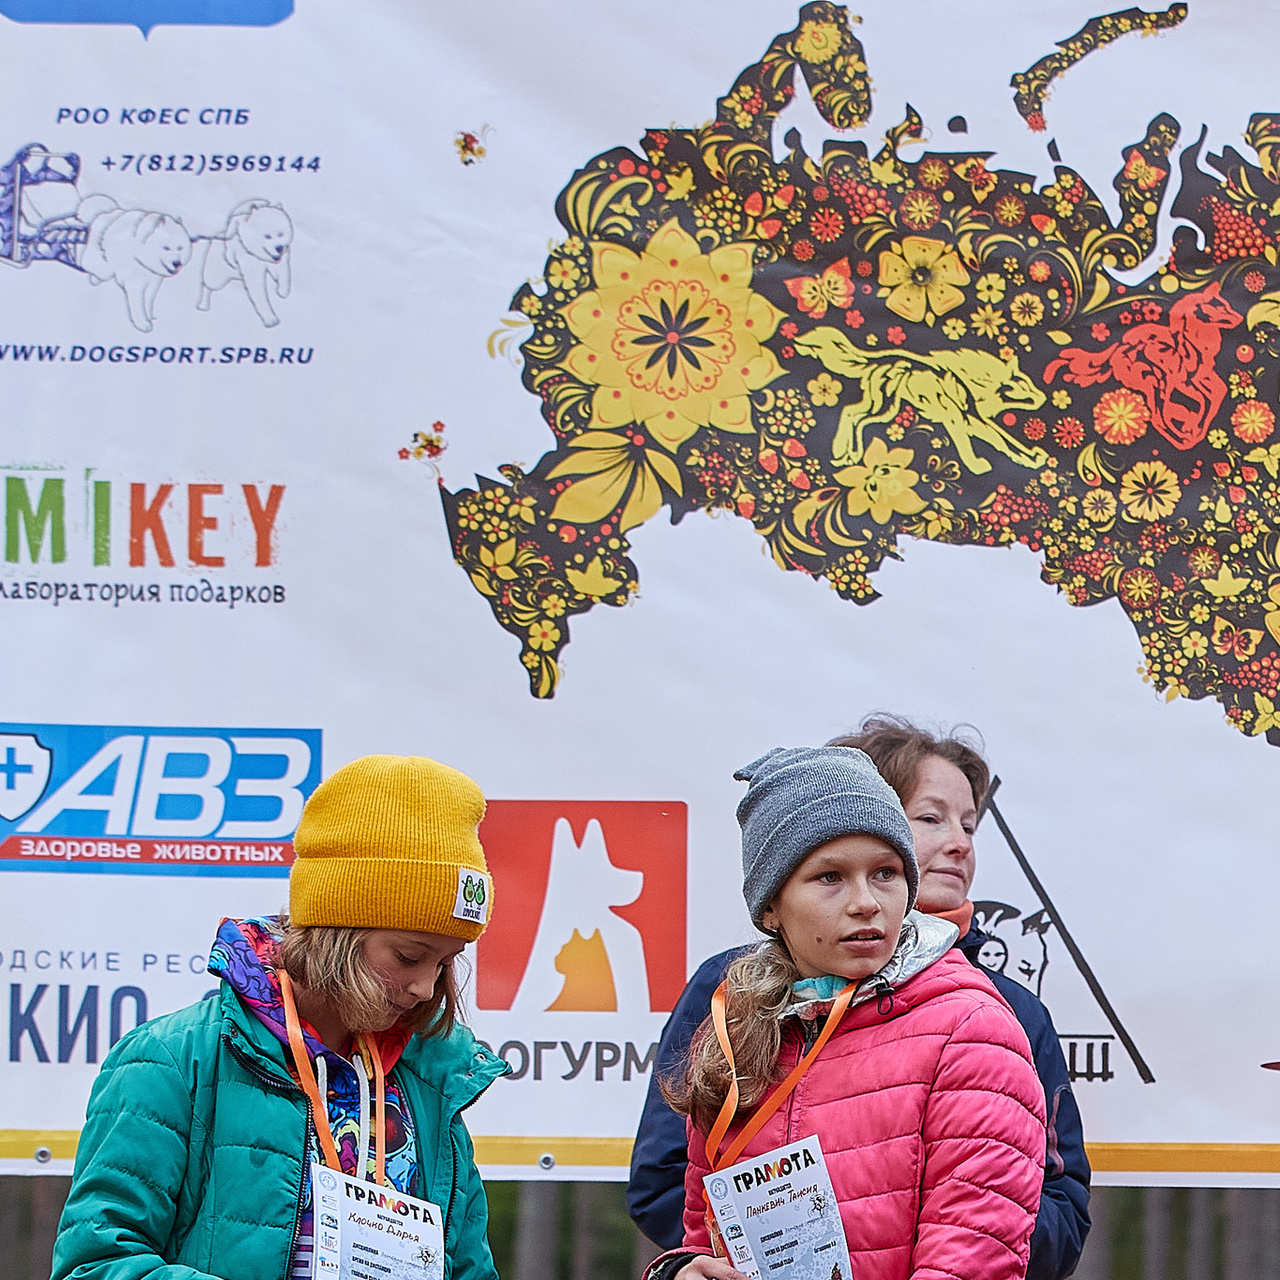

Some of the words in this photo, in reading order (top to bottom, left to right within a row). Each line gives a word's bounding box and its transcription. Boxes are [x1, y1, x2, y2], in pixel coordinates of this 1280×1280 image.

[56, 107, 110, 125] РОО
[120, 107, 190, 125] КФЕС
[199, 107, 250, 126] СПБ
[101, 154, 321, 176] +7(812)5969144
[4, 475, 287, 568] MIKEY
[169, 578, 286, 609] подарков
[16, 735, 312, 839] АВЗ
[153, 843, 284, 862] животных
[0, 949, 121, 972] ДСКИЕ
[733, 1148, 816, 1193] ГРАМОТА
[344, 1181, 436, 1226] ГРАМОТА
